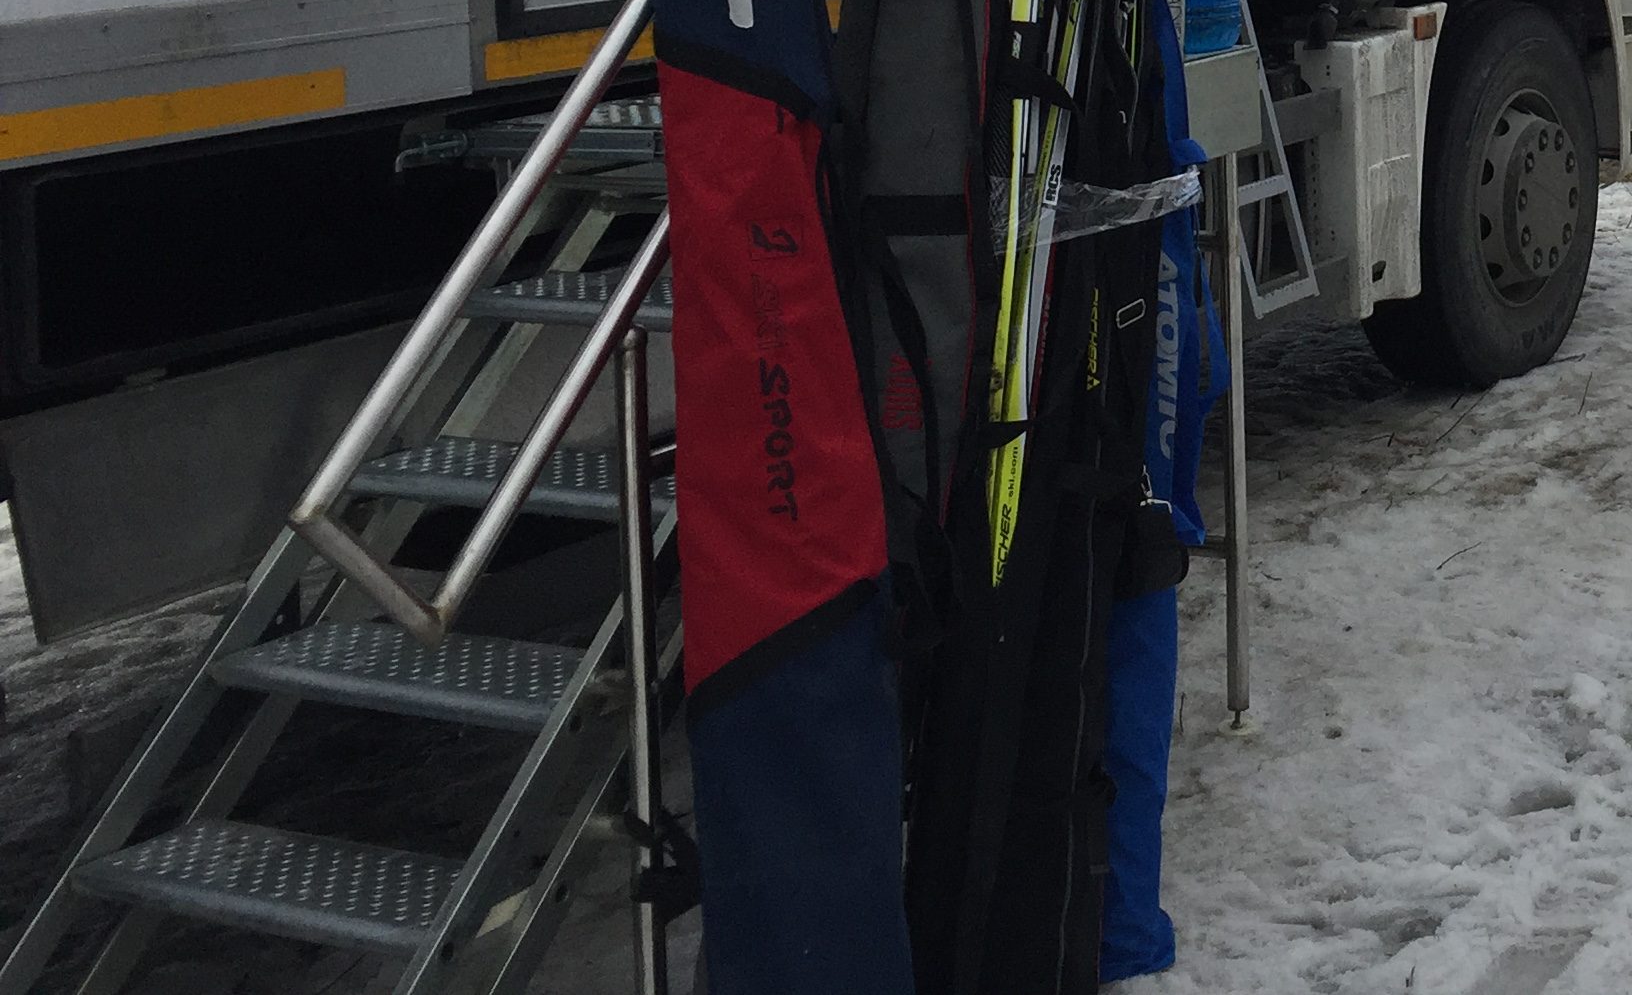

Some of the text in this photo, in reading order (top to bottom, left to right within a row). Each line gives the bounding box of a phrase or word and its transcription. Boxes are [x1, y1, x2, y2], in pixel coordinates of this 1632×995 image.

[1045, 164, 1061, 202] RCS
[1087, 287, 1099, 374] FISCHER
[1156, 251, 1179, 460] ATOMIC
[759, 357, 799, 522] SPORT
[995, 503, 1012, 585] ISCHER
